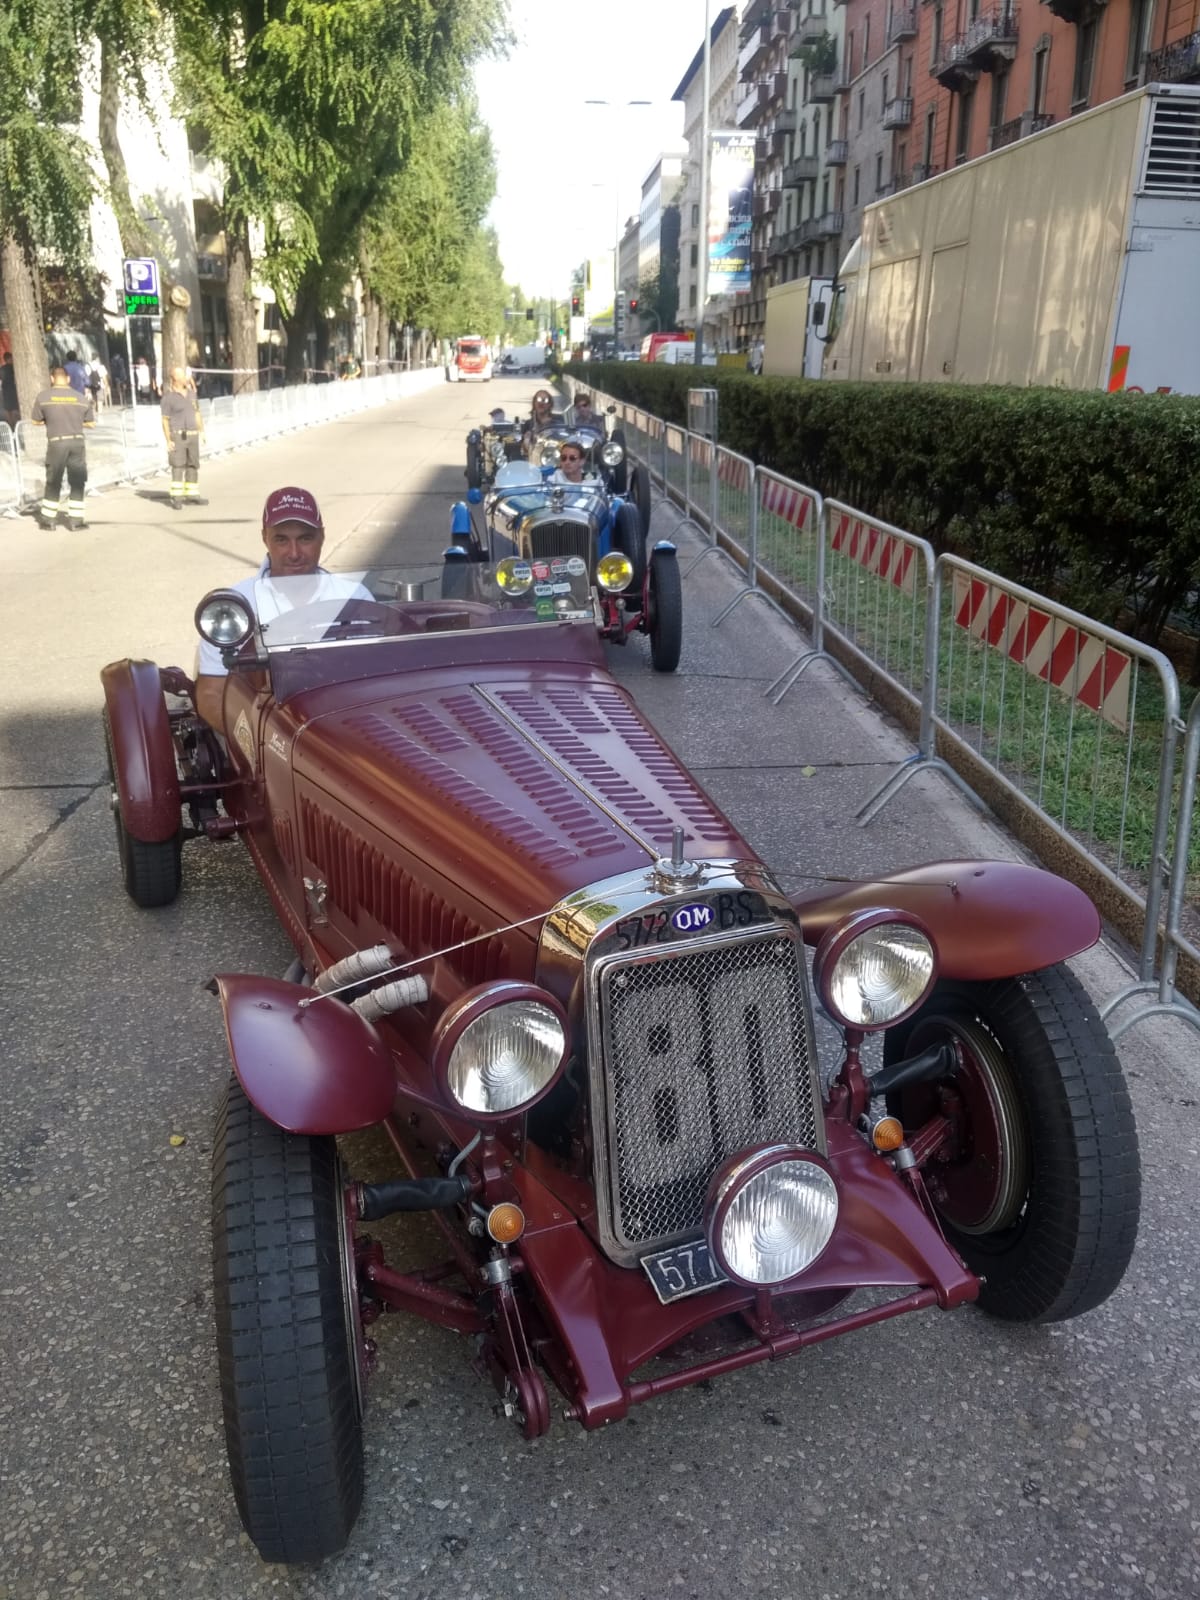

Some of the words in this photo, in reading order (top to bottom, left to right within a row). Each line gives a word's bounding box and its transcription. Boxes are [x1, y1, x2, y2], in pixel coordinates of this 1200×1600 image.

[130, 264, 149, 290] P
[125, 295, 159, 305] LIBERO
[615, 910, 670, 950] 5772
[676, 906, 711, 931] OM
[717, 890, 754, 930] BS
